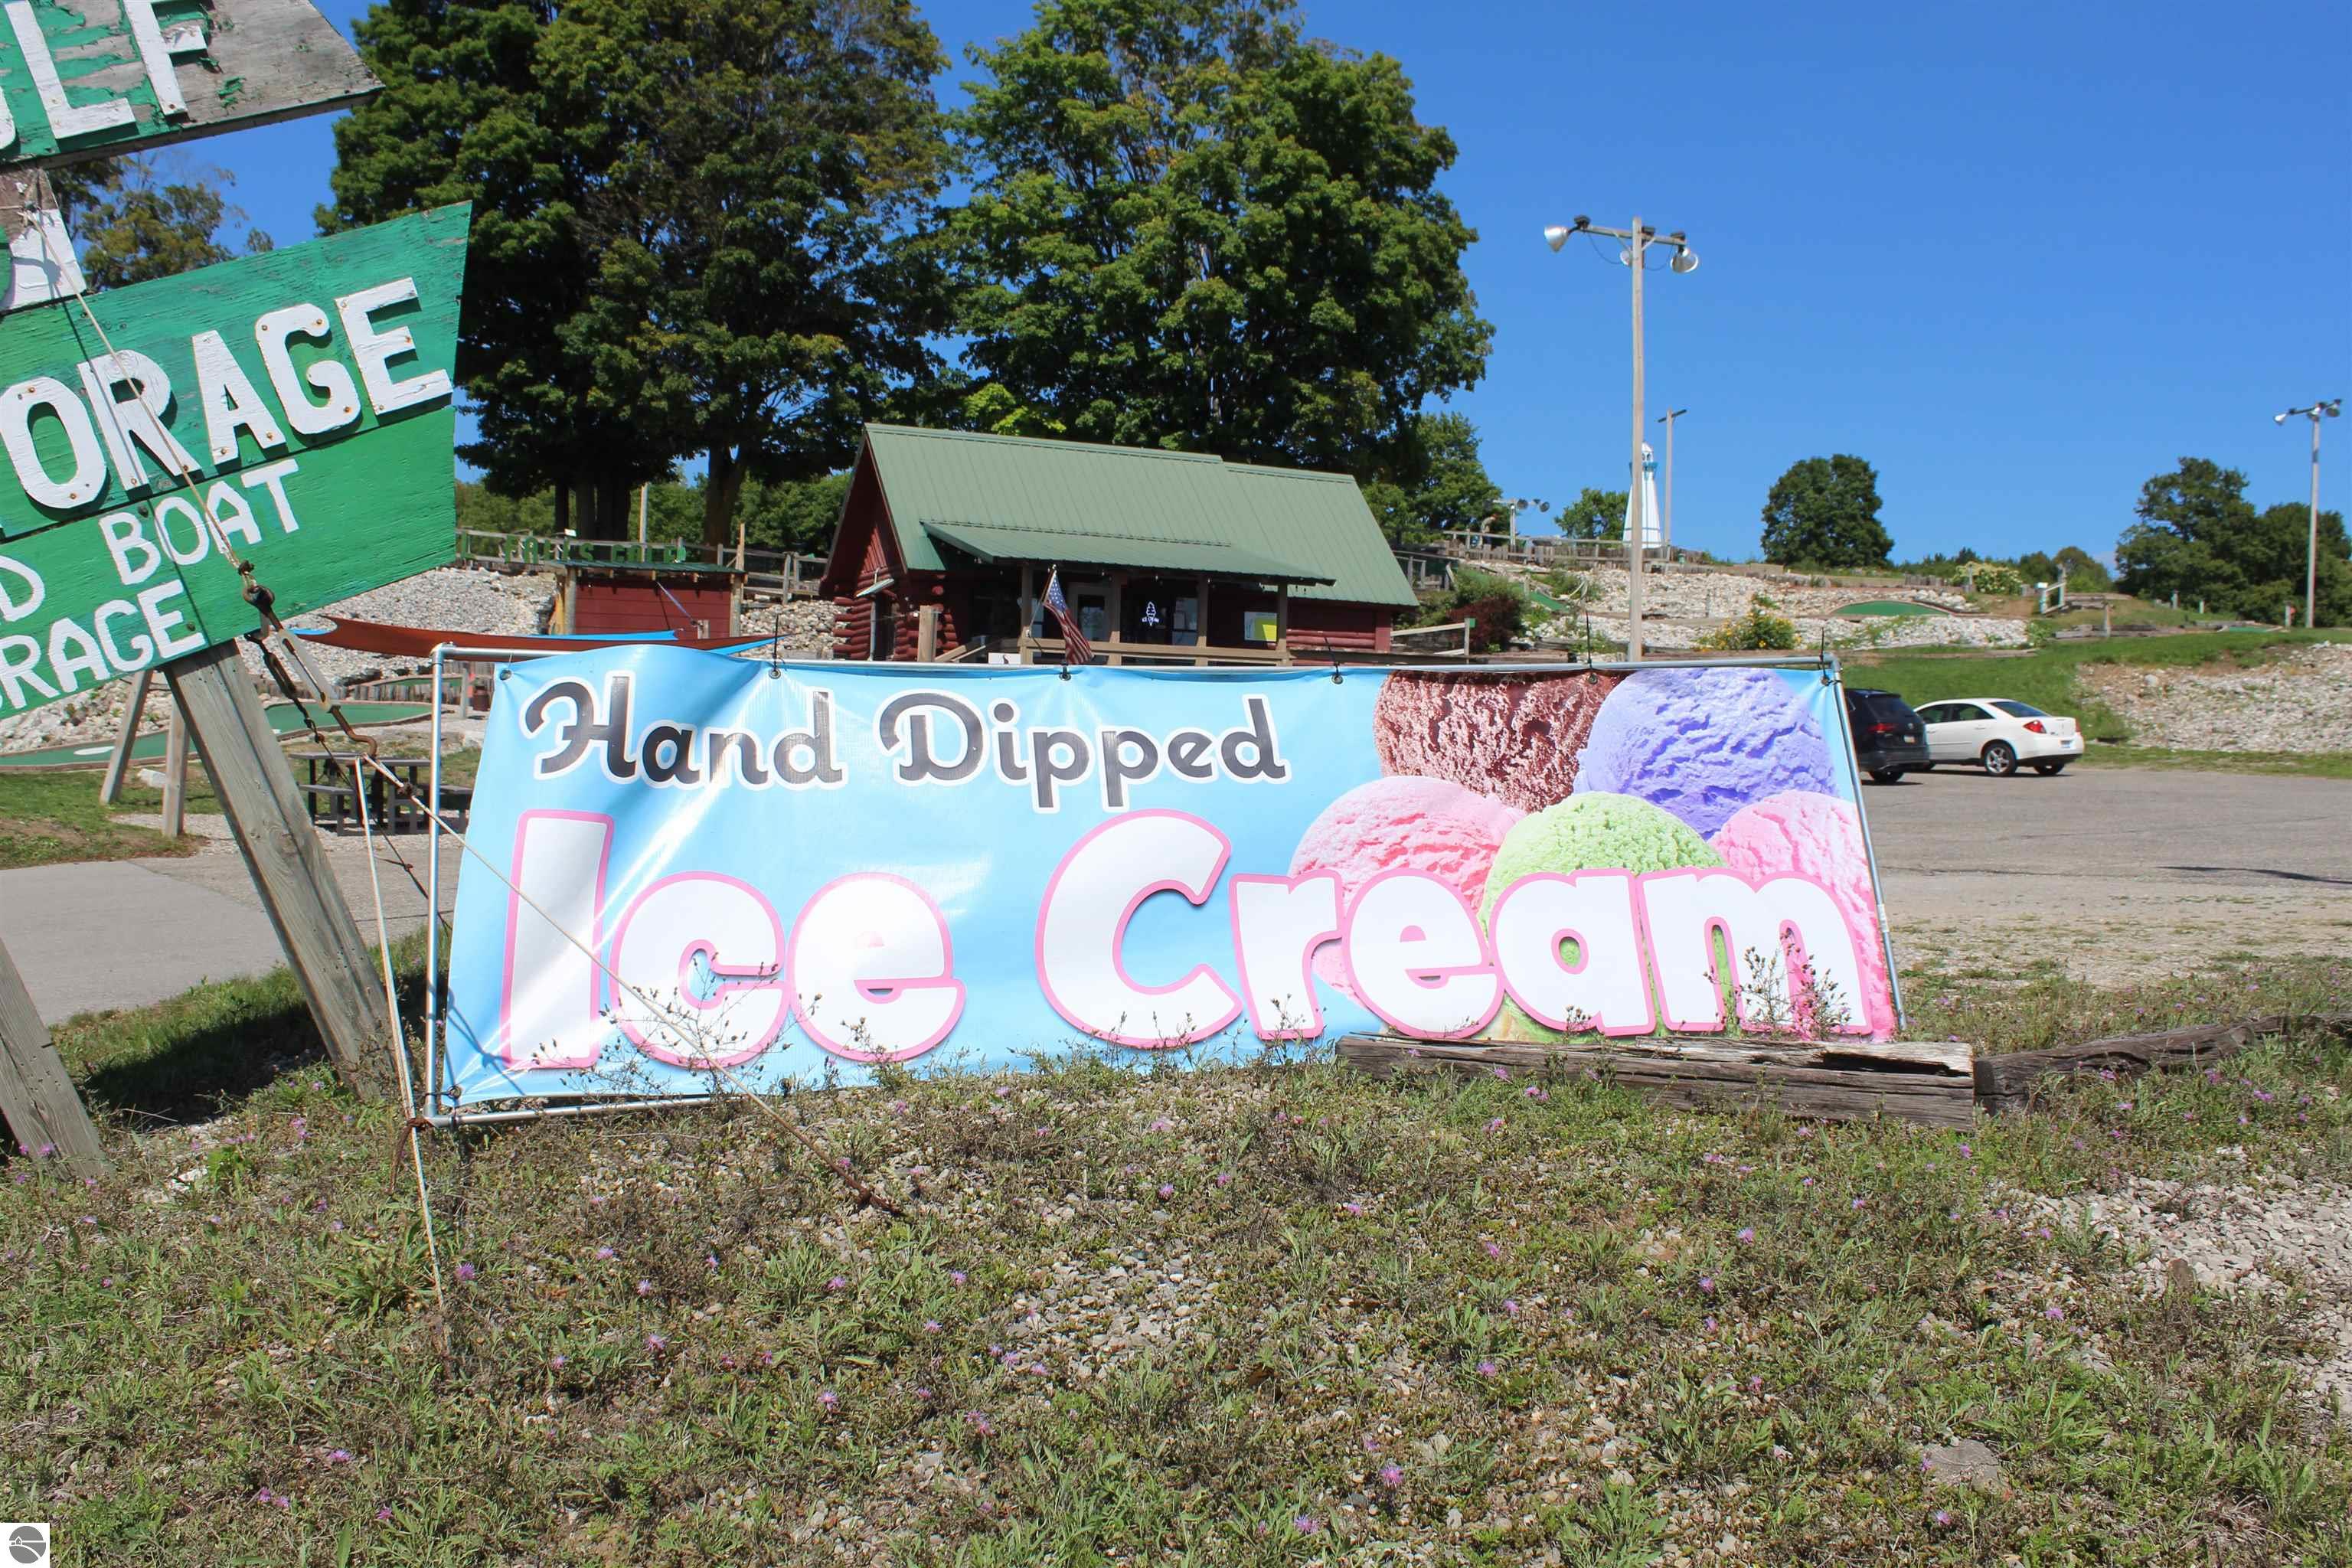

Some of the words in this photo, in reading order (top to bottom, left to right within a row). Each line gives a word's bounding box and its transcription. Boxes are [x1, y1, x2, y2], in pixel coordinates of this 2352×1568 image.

[0, 0, 208, 149] LF
[0, 277, 453, 508] ORAGE
[99, 459, 299, 585] BOAT
[0, 579, 207, 709] RAGE
[522, 672, 844, 786] Hand
[877, 690, 1289, 812] Dipped
[501, 809, 966, 1069] Ice
[1035, 808, 1873, 1047] Cream
